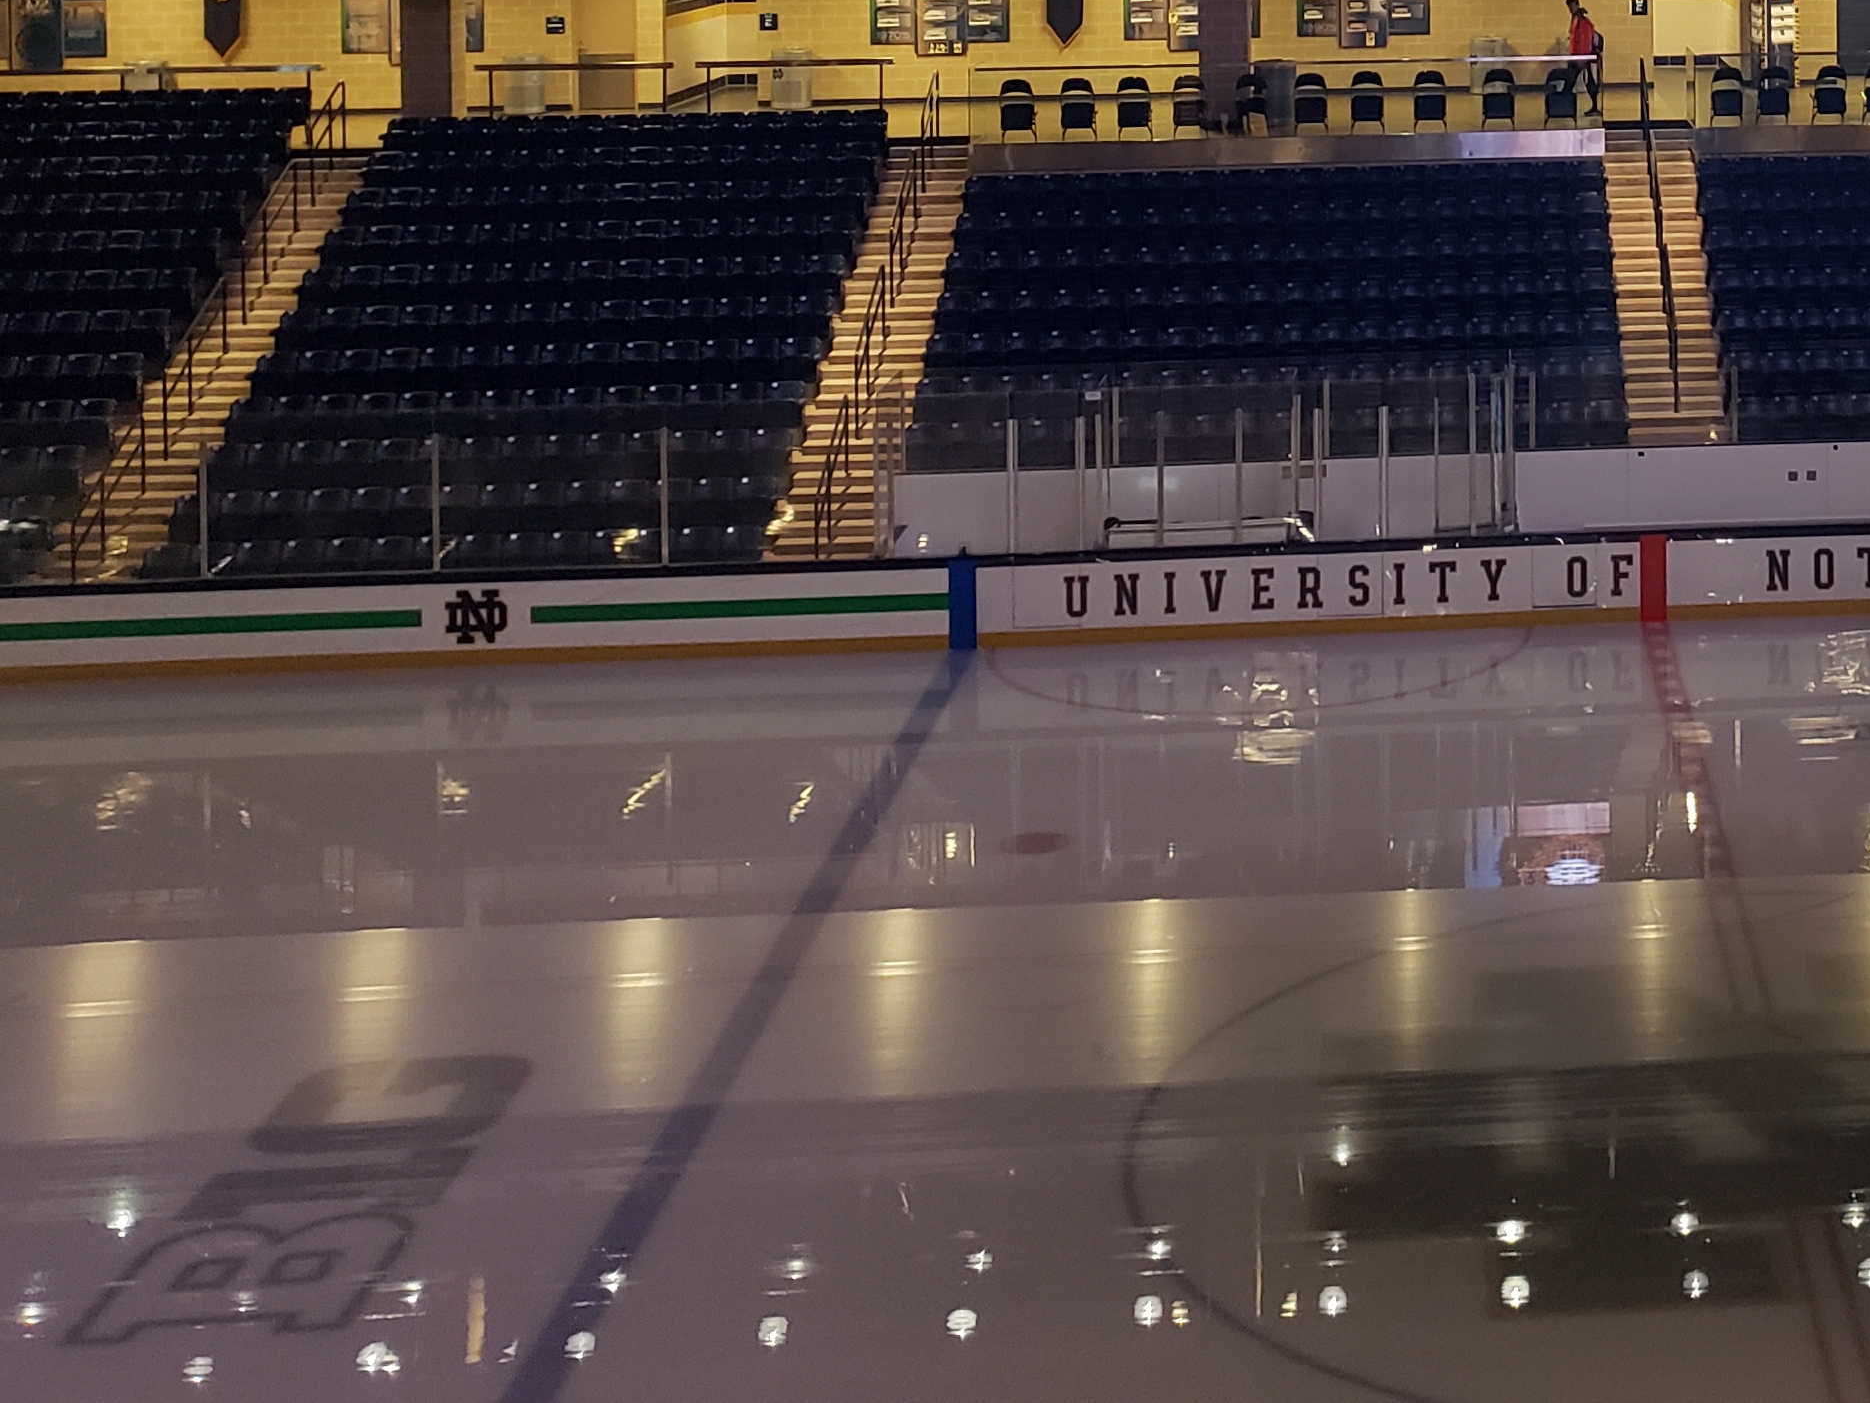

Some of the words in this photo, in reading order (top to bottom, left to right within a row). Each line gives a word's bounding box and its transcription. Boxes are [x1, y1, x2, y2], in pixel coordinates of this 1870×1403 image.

[1063, 558, 1507, 618] UNIVERSITY
[1565, 553, 1634, 598] OF
[445, 588, 508, 644] ND
